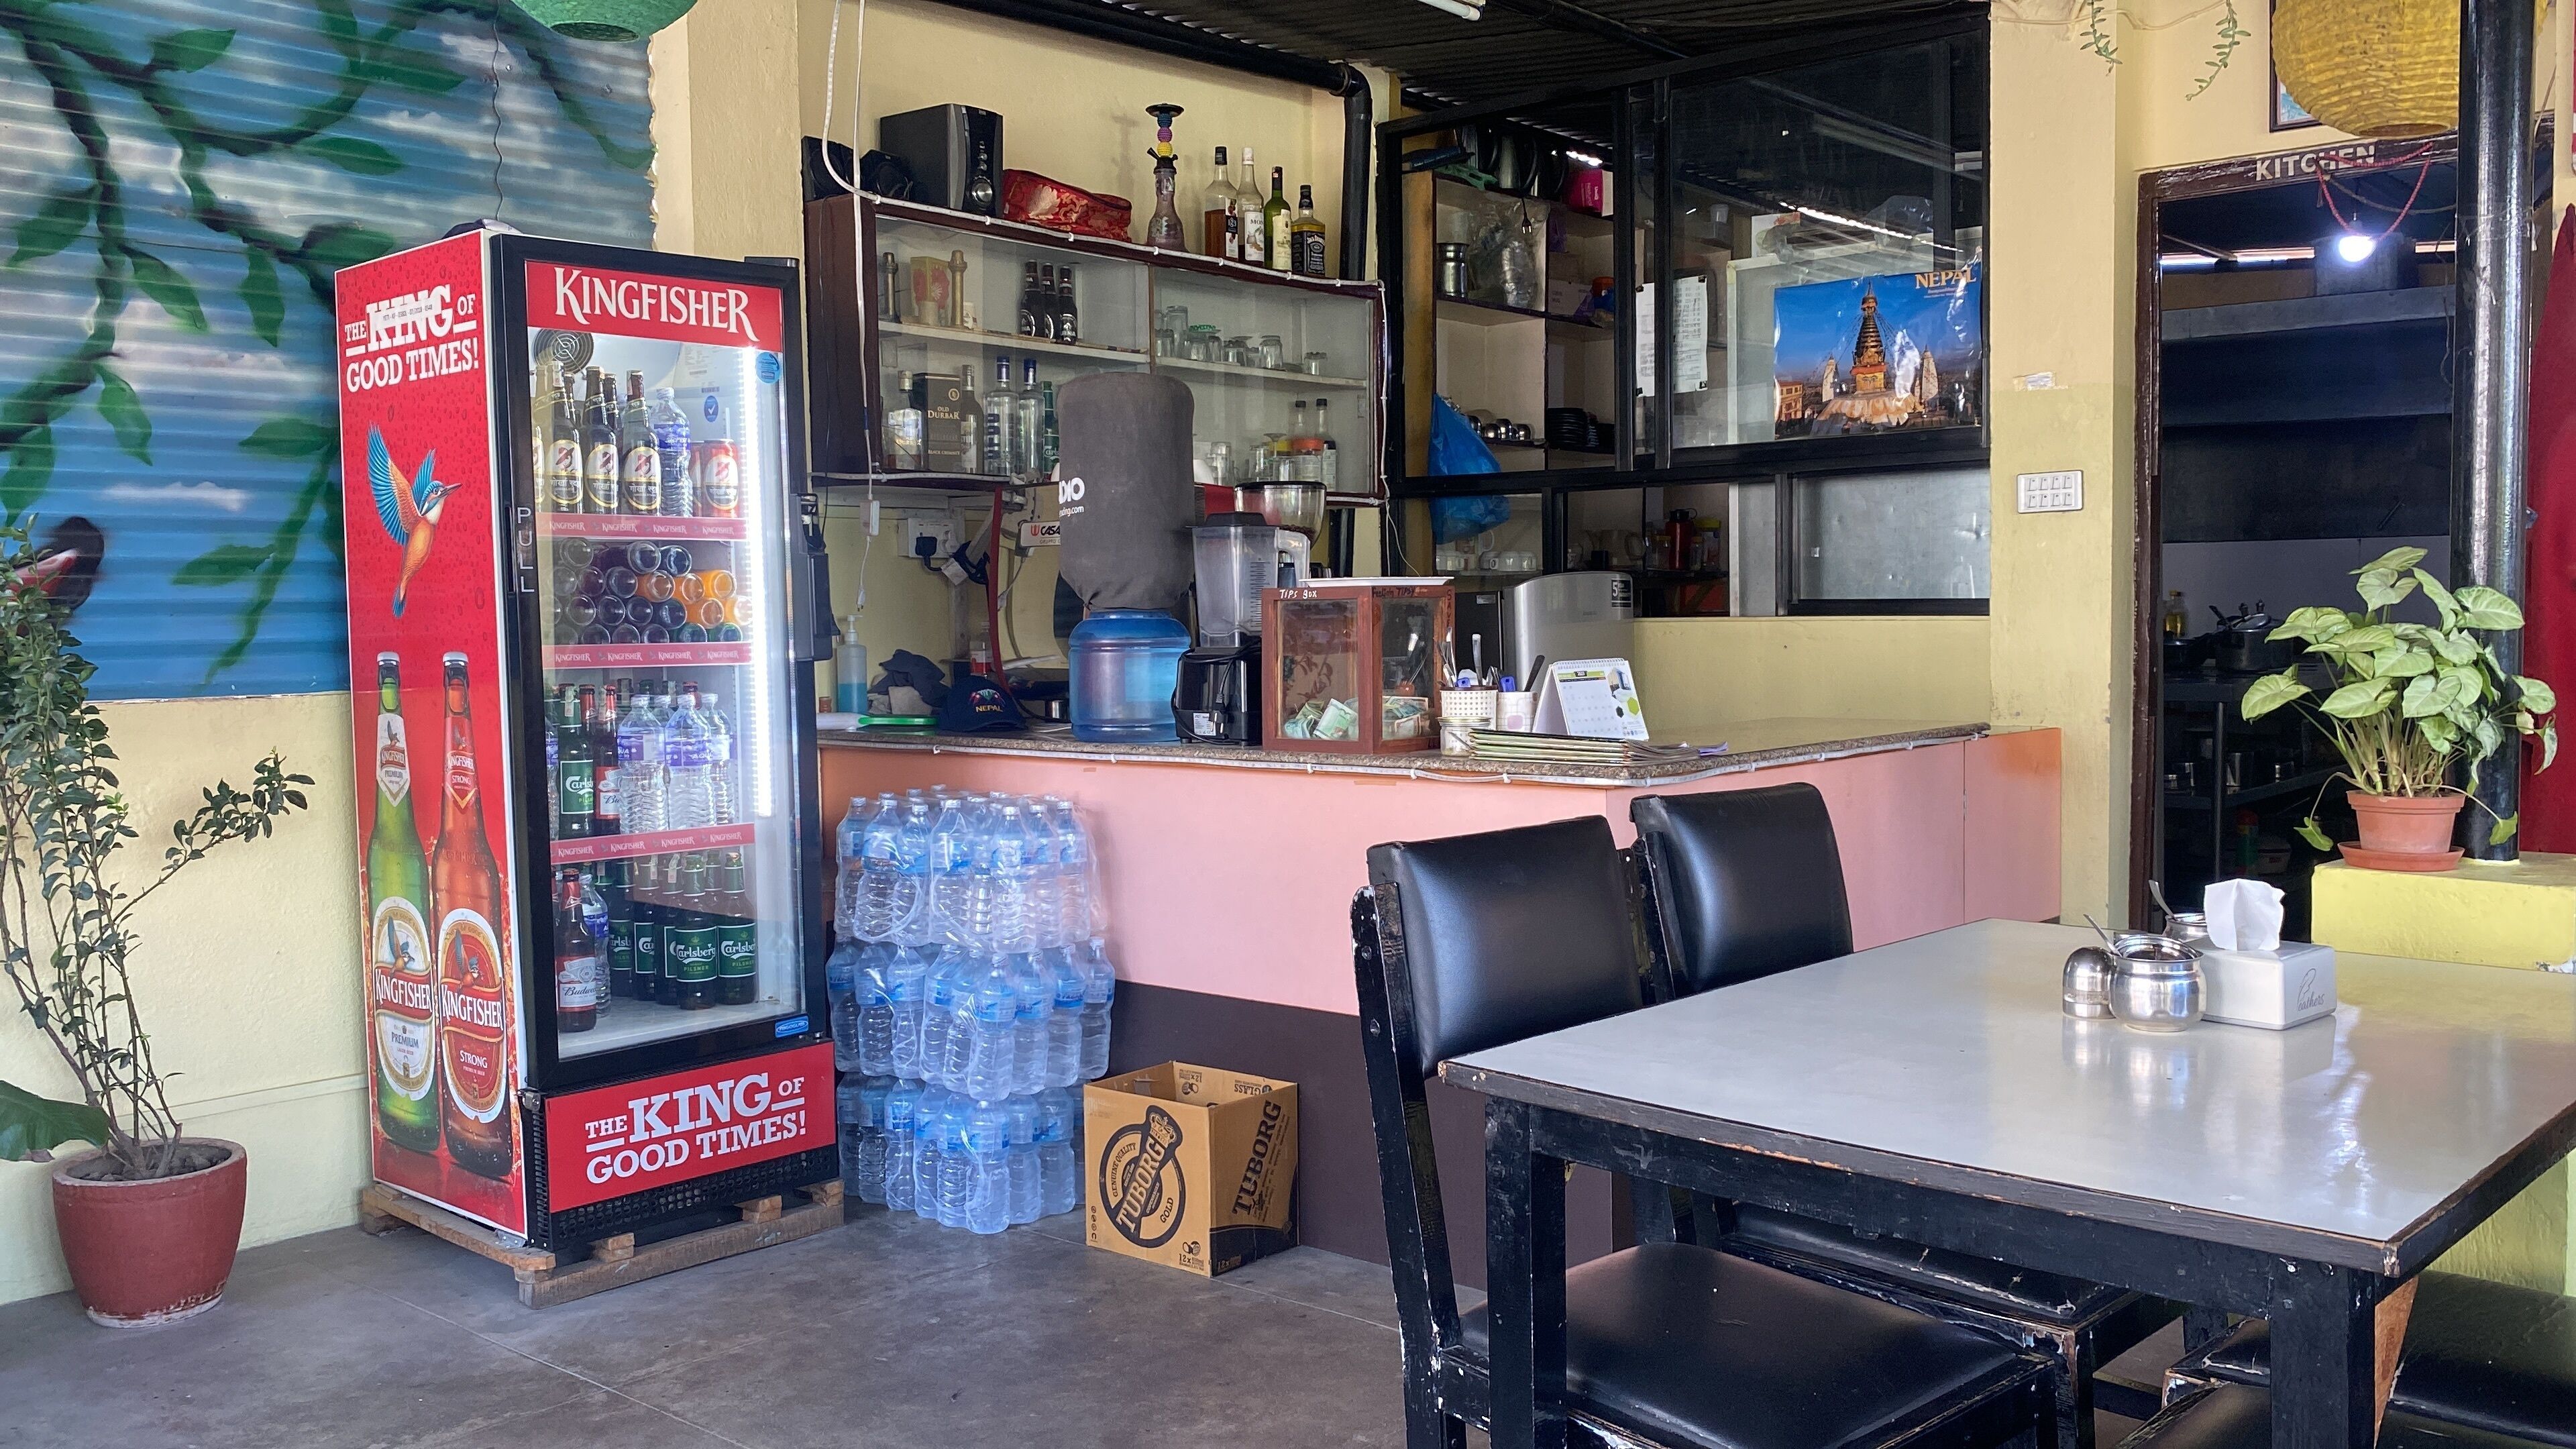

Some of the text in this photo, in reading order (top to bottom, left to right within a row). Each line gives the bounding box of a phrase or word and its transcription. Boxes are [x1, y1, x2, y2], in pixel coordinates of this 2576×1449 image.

[2256, 145, 2375, 181] KITCHEN
[1915, 268, 1976, 289] NEPAL
[555, 268, 760, 342] KINGFISHER
[345, 321, 366, 342] THE
[366, 284, 453, 352] KING
[457, 294, 476, 316] OF
[346, 337, 479, 392] GOOD TIMES!
[928, 410, 960, 419] DURBAR
[549, 521, 586, 531] KINGFISHER
[602, 523, 637, 533] KINGFISHER
[653, 524, 687, 535] KINGFISHER
[703, 526, 734, 536] KINGFISHER
[517, 507, 535, 592] PULL
[1612, 582, 1618, 597] 5
[555, 652, 591, 663] KINGFISHER
[608, 651, 643, 661] KINGFISHER
[658, 651, 692, 660] KINGFISHER
[707, 650, 739, 659] KINGFISHER
[451, 775, 472, 785] STRONG
[661, 836, 695, 848] KINGFISHER
[710, 832, 742, 843] KINGFISHER
[558, 845, 594, 857] KINGFISHER
[610, 841, 645, 853] KINGFISHER
[676, 944, 716, 961] Carlsberg
[376, 969, 433, 1012] KINGFISHER
[441, 984, 503, 1031] KINGFISHER
[391, 1032, 419, 1048] PREMIUM
[460, 1050, 488, 1069] STRONG
[586, 1072, 804, 1143] THE KING OF
[587, 1110, 806, 1184] GOOD TIMES!
[1116, 1143, 1136, 1163] QUALITY
[1232, 1100, 1281, 1216] TUBORG
[1116, 1136, 1166, 1233] TUBORG
[1160, 1197, 1174, 1223] GOLD
